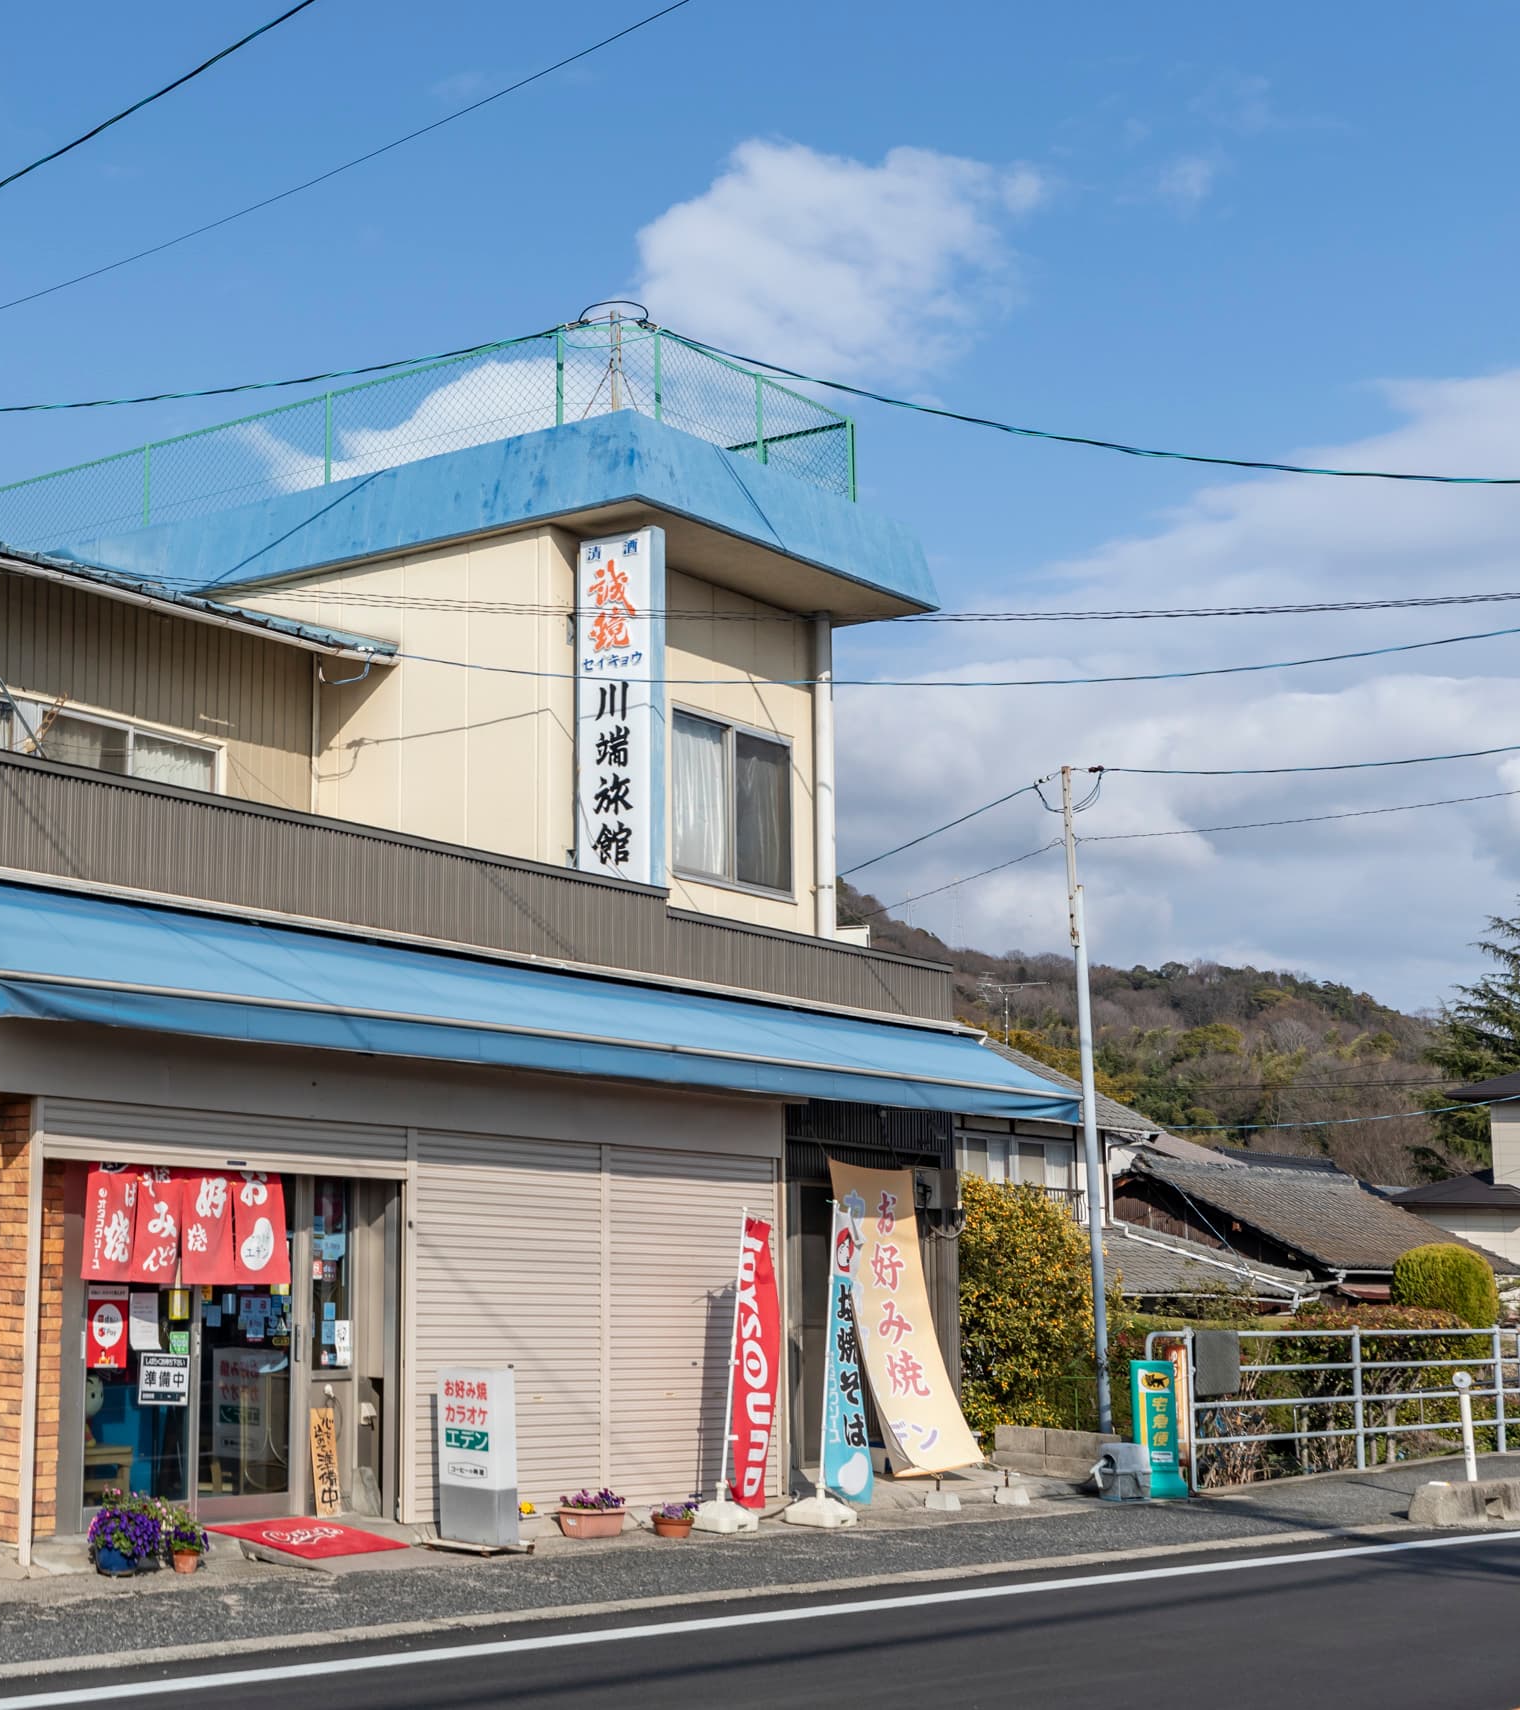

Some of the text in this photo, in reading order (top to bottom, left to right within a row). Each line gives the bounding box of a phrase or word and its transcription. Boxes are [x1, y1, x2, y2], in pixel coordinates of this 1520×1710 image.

[587, 538, 639, 561] 清酒
[589, 560, 636, 651] 誠鏡
[583, 650, 643, 672] セイキョウ
[592, 681, 633, 867] 川端旅館
[871, 1190, 931, 1398] お好み焼
[144, 1370, 185, 1388] 準備中
[444, 1379, 488, 1401] お好み焼
[445, 1404, 488, 1426] カラオケ
[446, 1429, 488, 1449] エデン
[890, 1418, 939, 1451] デン
